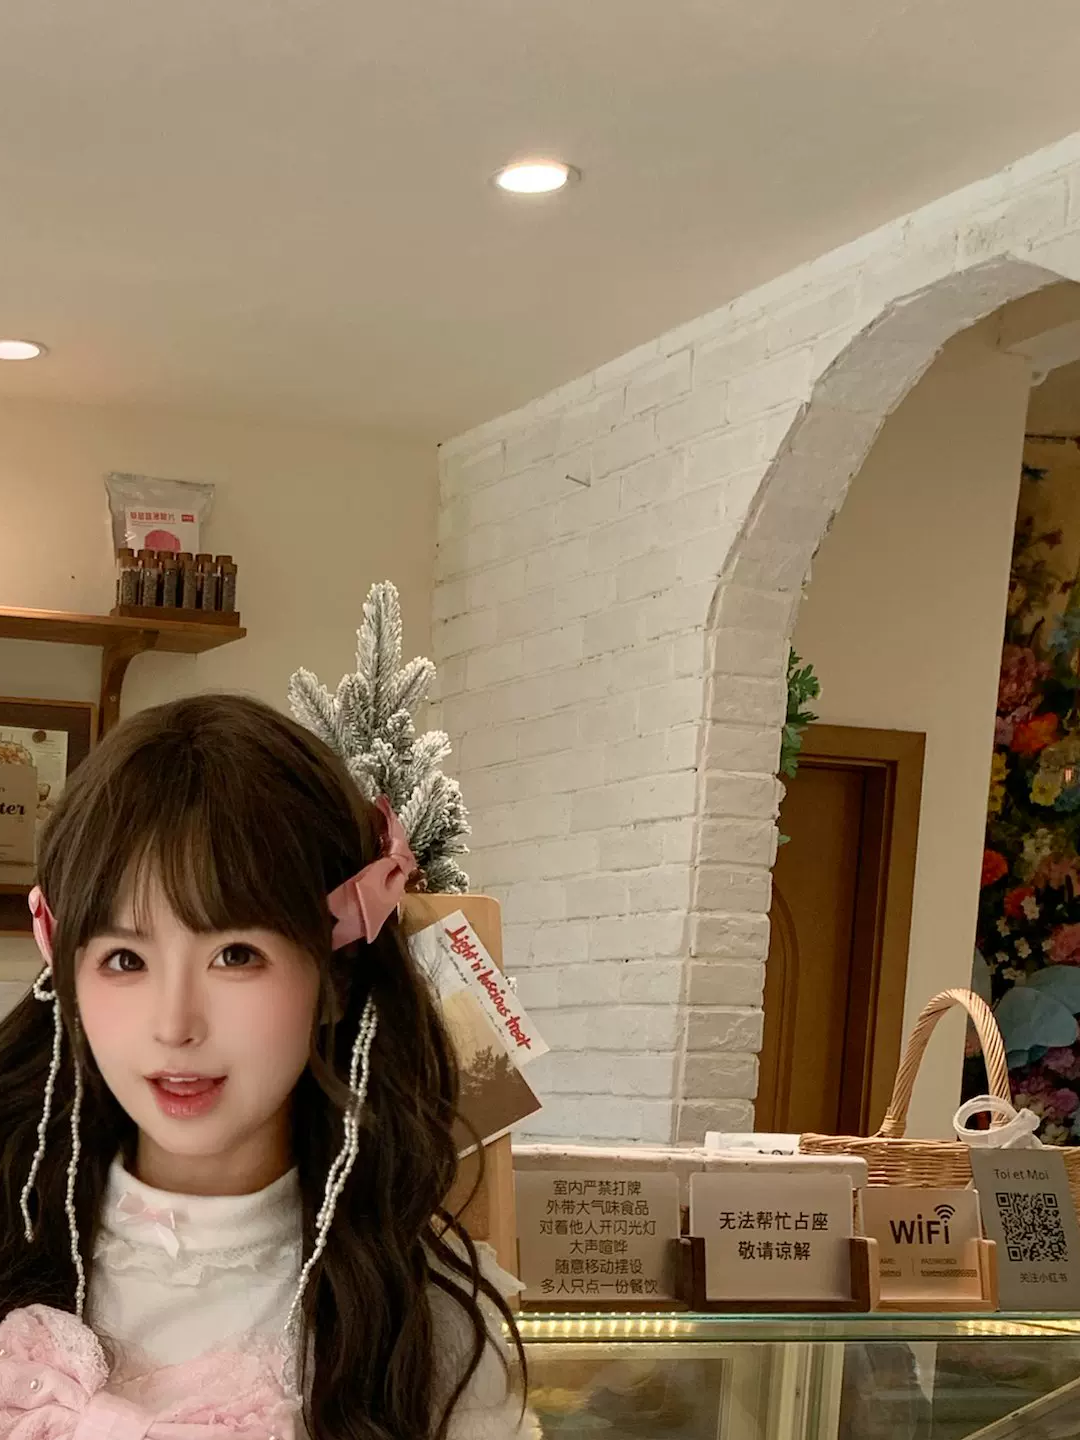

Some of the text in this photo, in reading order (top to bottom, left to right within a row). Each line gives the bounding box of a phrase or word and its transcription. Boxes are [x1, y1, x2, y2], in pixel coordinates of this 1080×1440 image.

[444, 925, 479, 961] Light
[506, 1016, 531, 1050] treat
[993, 1168, 1049, 1181] Toi et Moi
[552, 1180, 642, 1196] 室内严禁打牌
[546, 1200, 650, 1216] 外带大气味食品
[539, 1219, 657, 1236] 对着他人开闪光灯
[719, 1211, 829, 1232] 无法帮忙占座
[569, 1239, 629, 1255] 大声喧哗
[737, 1240, 812, 1261] 敬请谅解
[554, 1259, 643, 1275] 随意移动摆设
[540, 1278, 658, 1294] 多人只点一份餐饮
[1019, 1272, 1069, 1284] 关注小红书
